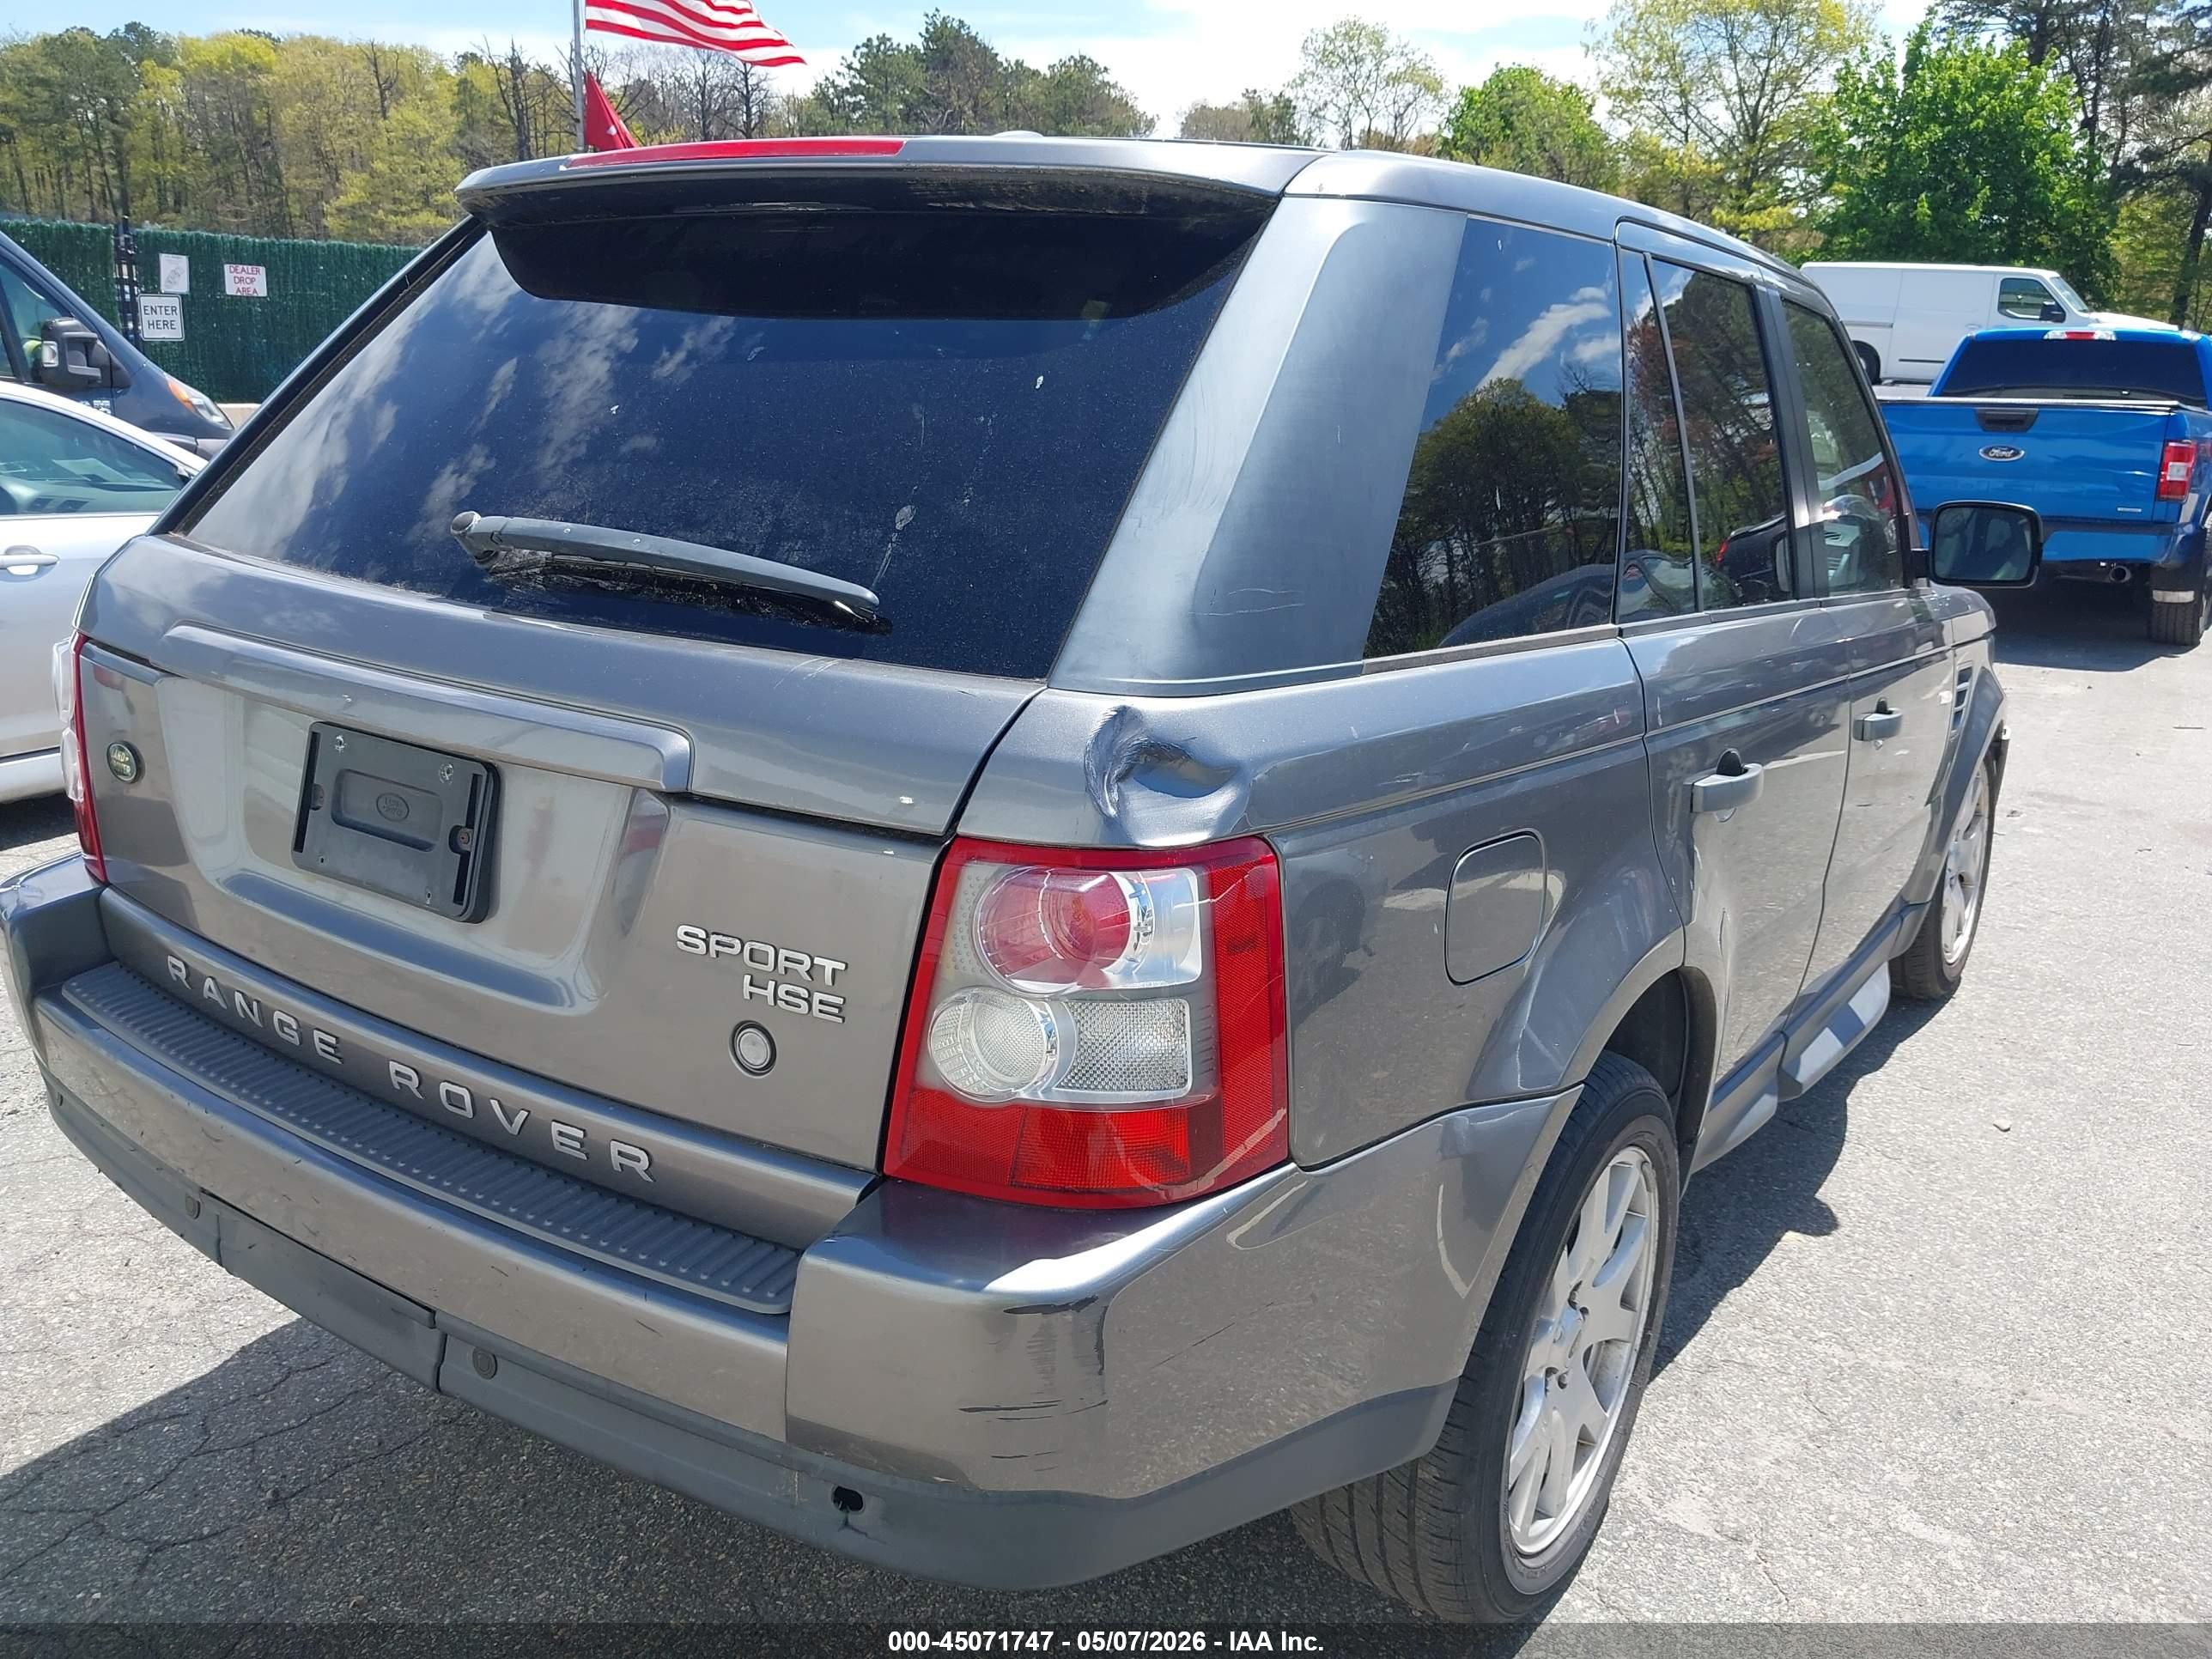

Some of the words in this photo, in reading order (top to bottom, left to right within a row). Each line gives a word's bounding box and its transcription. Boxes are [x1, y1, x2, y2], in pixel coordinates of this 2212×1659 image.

[228, 265, 261, 276] DEALER
[234, 276, 256, 285] DROP
[235, 287, 258, 295] AREA
[143, 305, 178, 316] ENTER
[148, 319, 177, 330] HERE
[1988, 448, 2015, 457] Ford
[676, 923, 848, 987] SPORT
[742, 973, 846, 1024] HSE
[167, 954, 343, 1065] RANGE
[388, 1060, 656, 1183] ROVER
